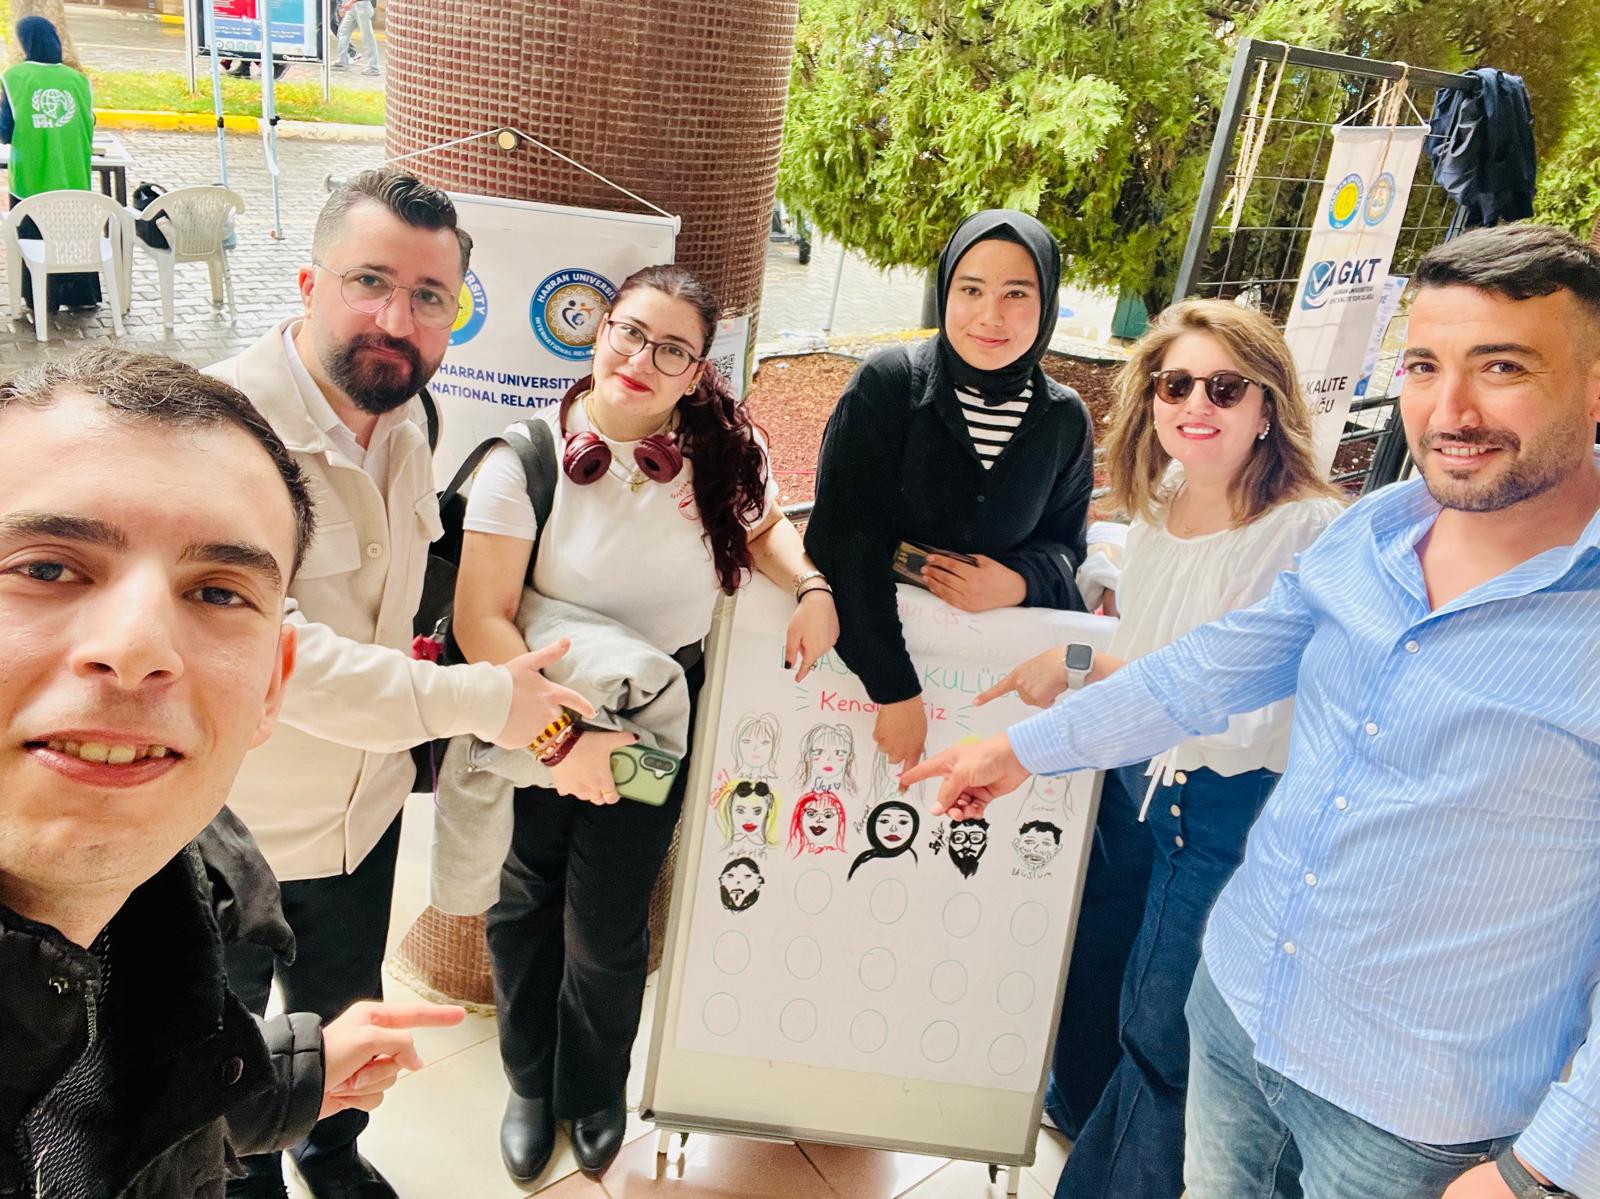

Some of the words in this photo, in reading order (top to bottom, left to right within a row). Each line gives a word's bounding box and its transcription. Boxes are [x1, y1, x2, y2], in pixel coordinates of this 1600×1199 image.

[1338, 258, 1382, 284] GKT
[463, 270, 486, 315] RSITY
[537, 273, 570, 304] HARRAN
[535, 316, 572, 356] INTERNATIONAL
[440, 364, 494, 382] HARRAN
[430, 382, 498, 403] NATIONAL
